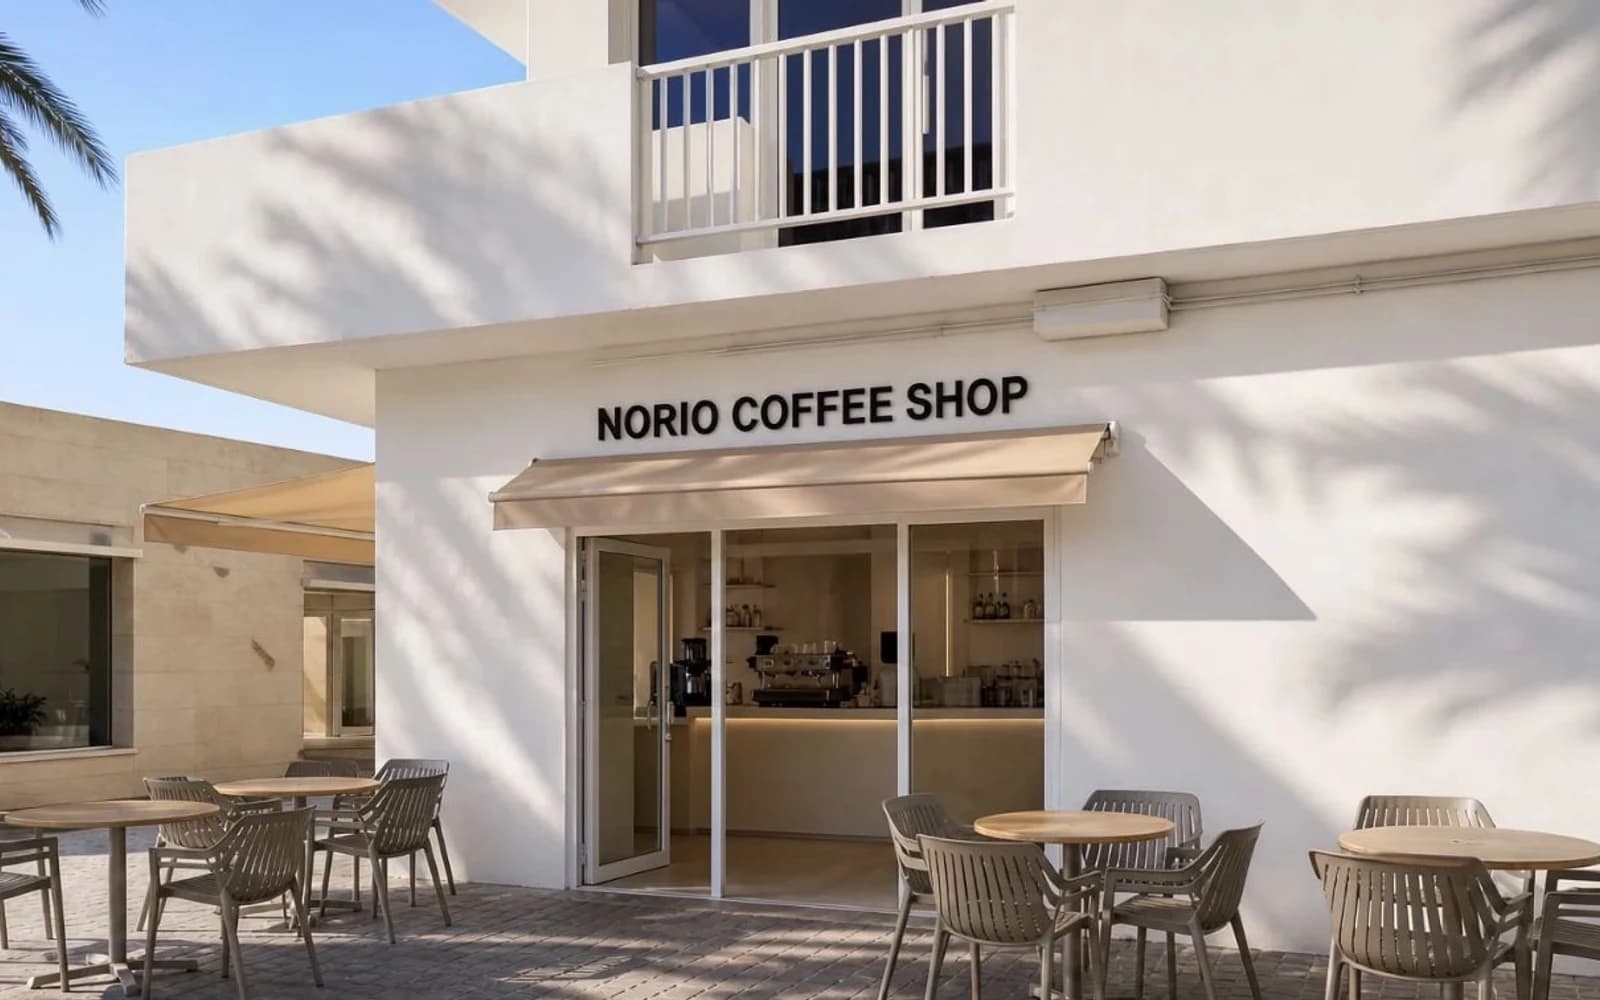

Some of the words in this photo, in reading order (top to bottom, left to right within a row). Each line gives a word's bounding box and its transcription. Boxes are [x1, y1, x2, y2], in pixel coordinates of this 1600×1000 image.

[597, 400, 719, 441] NORIO
[732, 386, 894, 433] COFFEE
[907, 375, 1029, 420] SHOP
